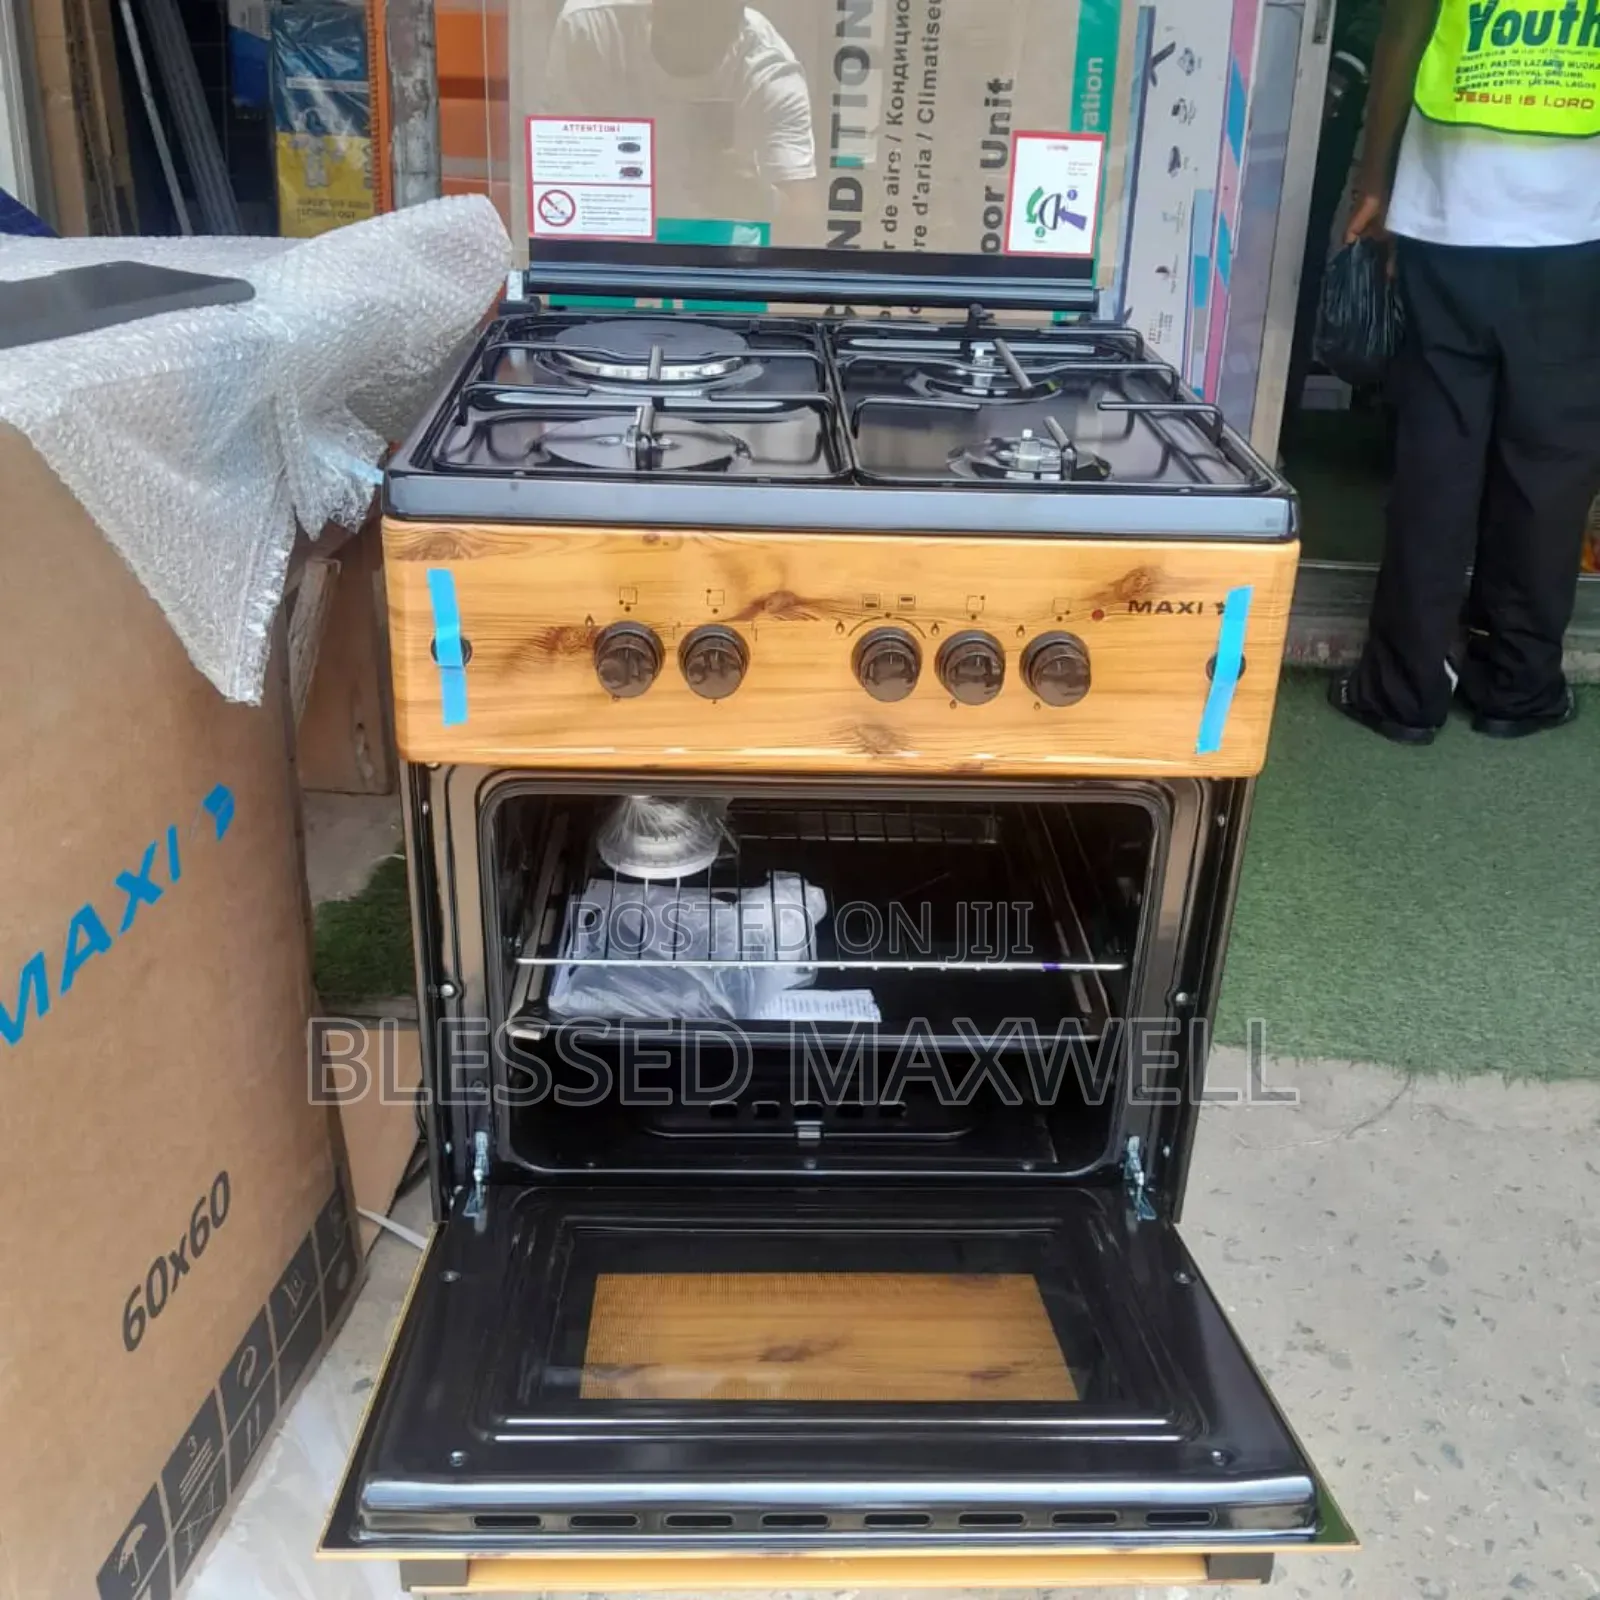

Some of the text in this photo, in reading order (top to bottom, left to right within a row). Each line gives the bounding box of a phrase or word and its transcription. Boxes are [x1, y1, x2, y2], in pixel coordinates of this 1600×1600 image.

[1544, 95, 1595, 109] LORD
[980, 77, 1014, 170] Unit
[882, 151, 902, 196] aire
[880, 205, 898, 232] de
[1128, 600, 1204, 614] MAXI
[121, 1169, 232, 1353] 60x60
